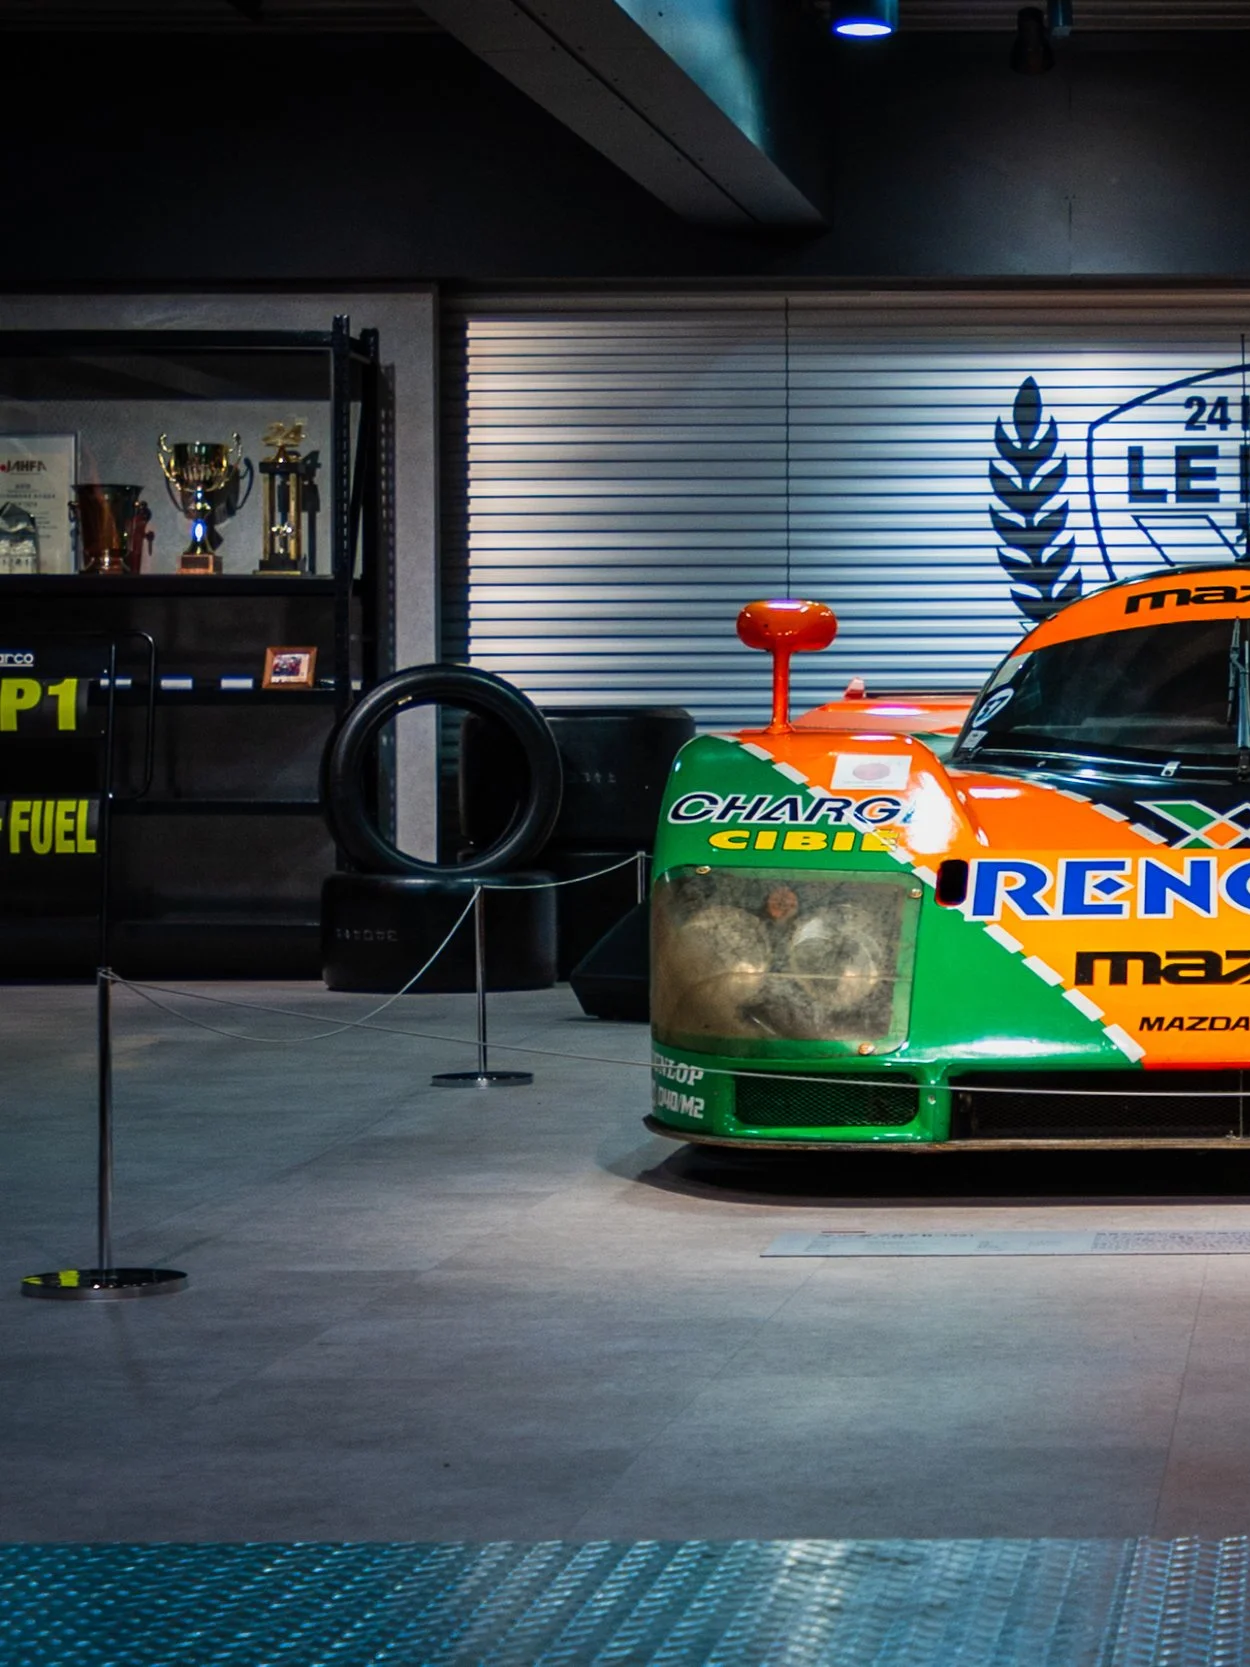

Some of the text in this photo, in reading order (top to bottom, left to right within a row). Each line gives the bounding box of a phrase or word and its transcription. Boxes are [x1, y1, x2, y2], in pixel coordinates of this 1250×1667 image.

[1185, 395, 1232, 432] 24
[1128, 445, 1220, 503] LE
[9, 799, 97, 854] FUEL
[668, 791, 918, 825] CHARG
[1138, 1015, 1250, 1032] MAZDA
